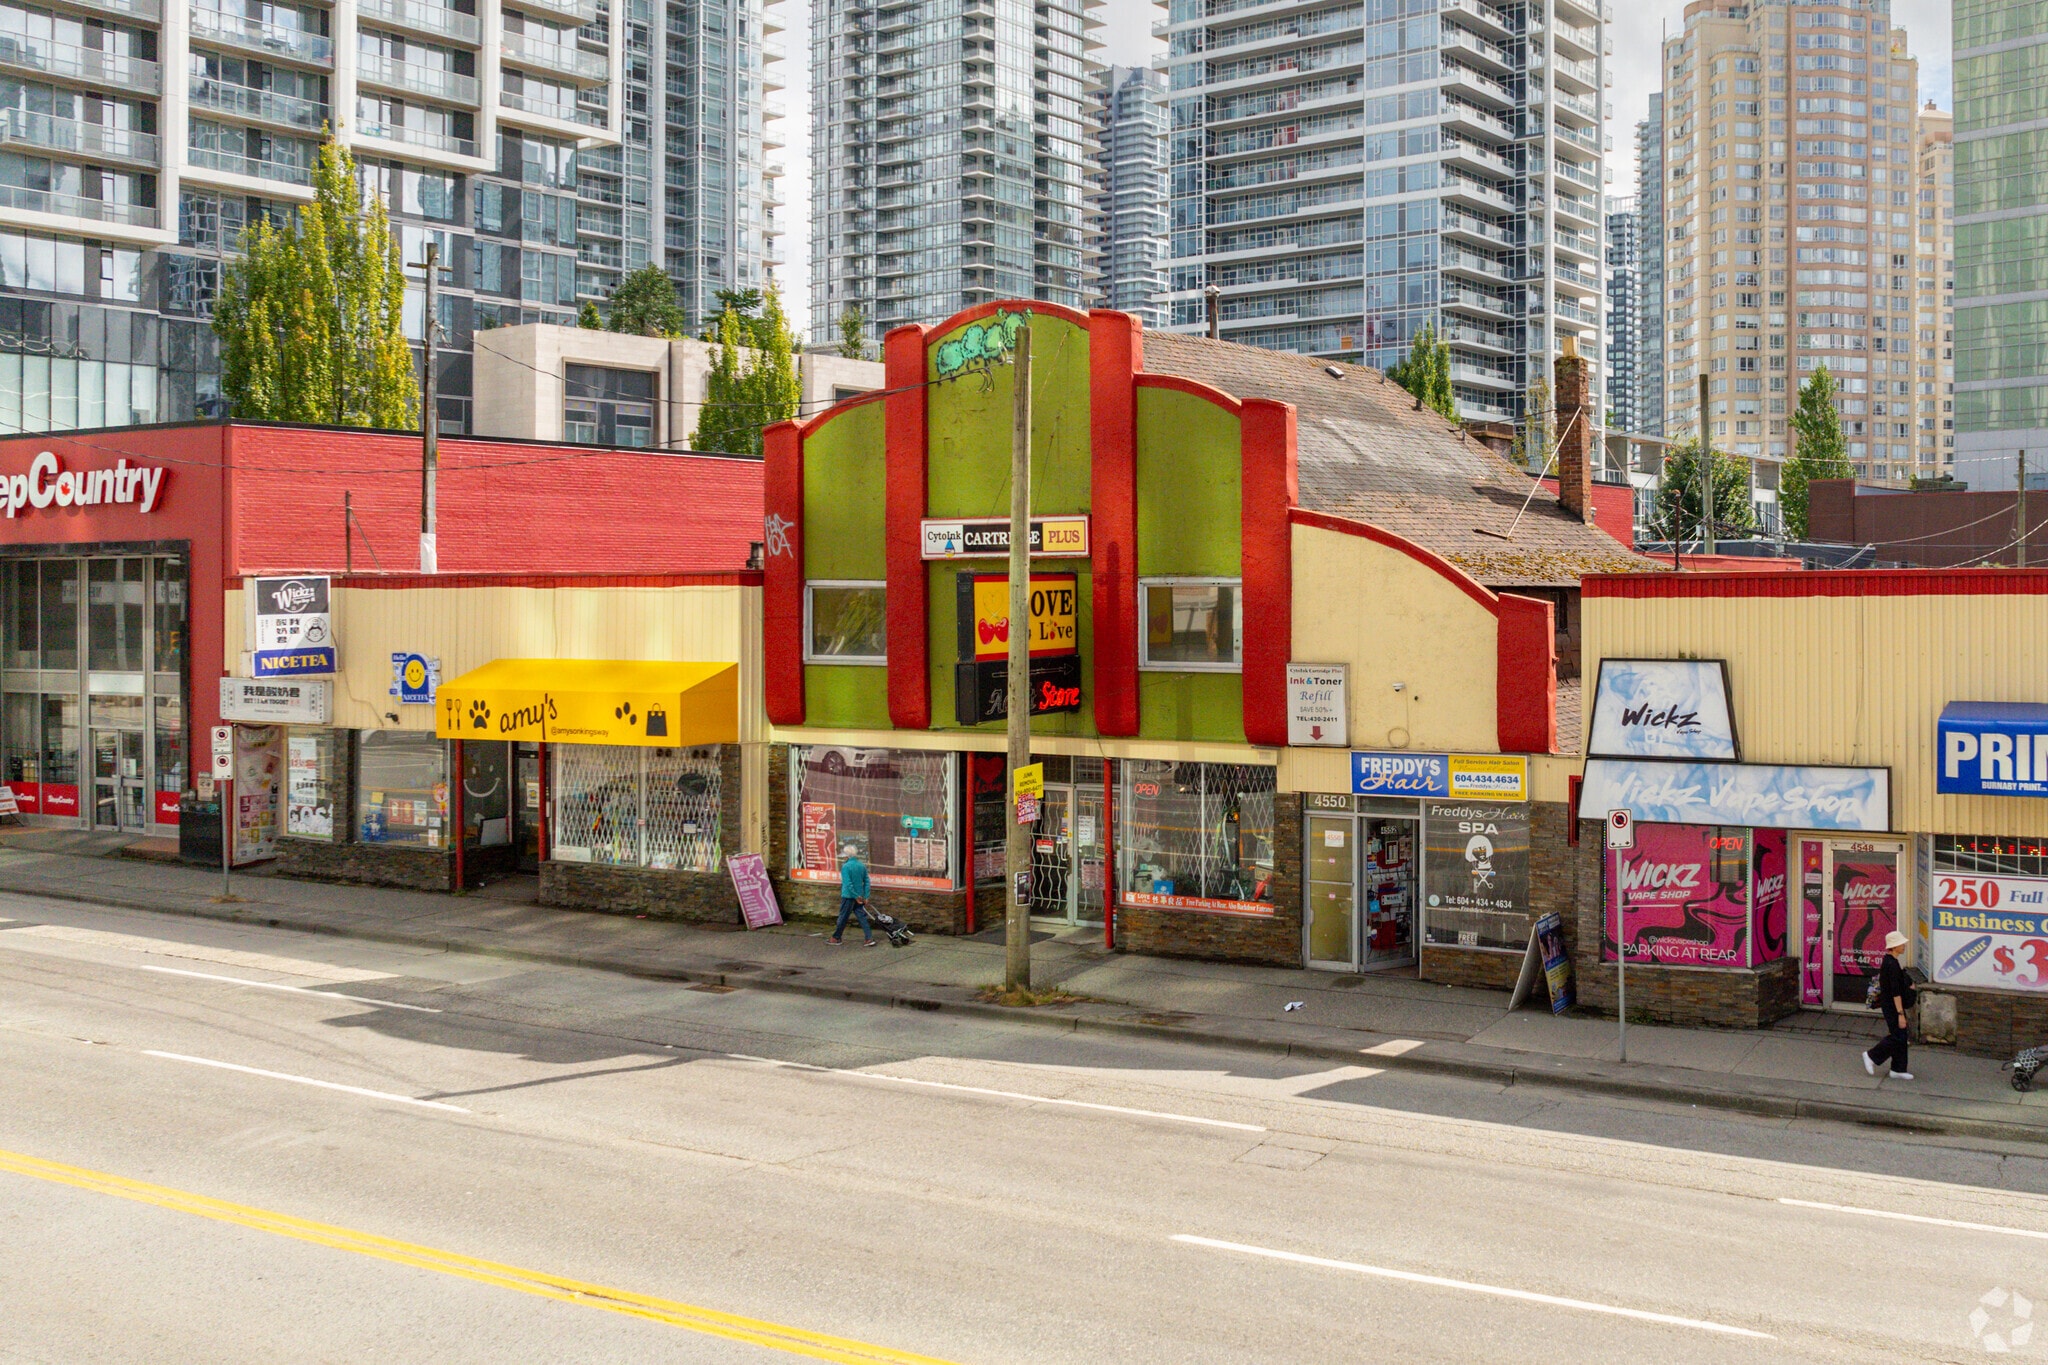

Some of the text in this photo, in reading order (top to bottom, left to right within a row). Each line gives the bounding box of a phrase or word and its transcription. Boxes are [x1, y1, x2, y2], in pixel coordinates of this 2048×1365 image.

[928, 530, 1080, 546] CytoInk CARTRIE PLUS
[1031, 590, 1072, 616] OVE
[261, 654, 328, 670] NICETEA
[1314, 677, 1342, 685] Toner
[1039, 681, 1080, 709] Store
[1300, 690, 1334, 704] Refill
[500, 693, 557, 740] amy's
[1622, 702, 1701, 729] Wickz
[1361, 757, 1441, 775] FREDDY'S
[1360, 769, 1443, 791] Hair
[1455, 774, 1519, 783] 604.434.4634
[1982, 781, 2017, 790] BURNABY
[2018, 782, 2042, 791] PRINT
[1134, 783, 1159, 796] OPEN
[1604, 771, 1862, 823] Wickz Vape Shop
[1314, 795, 1346, 808] 4550
[1431, 805, 1483, 819] Freddys
[1458, 822, 1499, 835] SPA
[1709, 837, 1744, 851] OPEN
[1850, 843, 1874, 852] 4548
[1622, 859, 1701, 890] WICKZ
[1756, 874, 1785, 898] WICKZ
[1843, 882, 1891, 899] WICKZ
[1938, 878, 2043, 908] 250 Full
[1457, 896, 1469, 905] 604
[1476, 898, 1488, 906] 434
[1495, 899, 1512, 909] 4634
[1628, 890, 1691, 900] VAPE SHOP
[1938, 911, 2035, 933] Business
[1622, 943, 1737, 962] PARKING AT REAR
[1960, 940, 1987, 963] Hour
